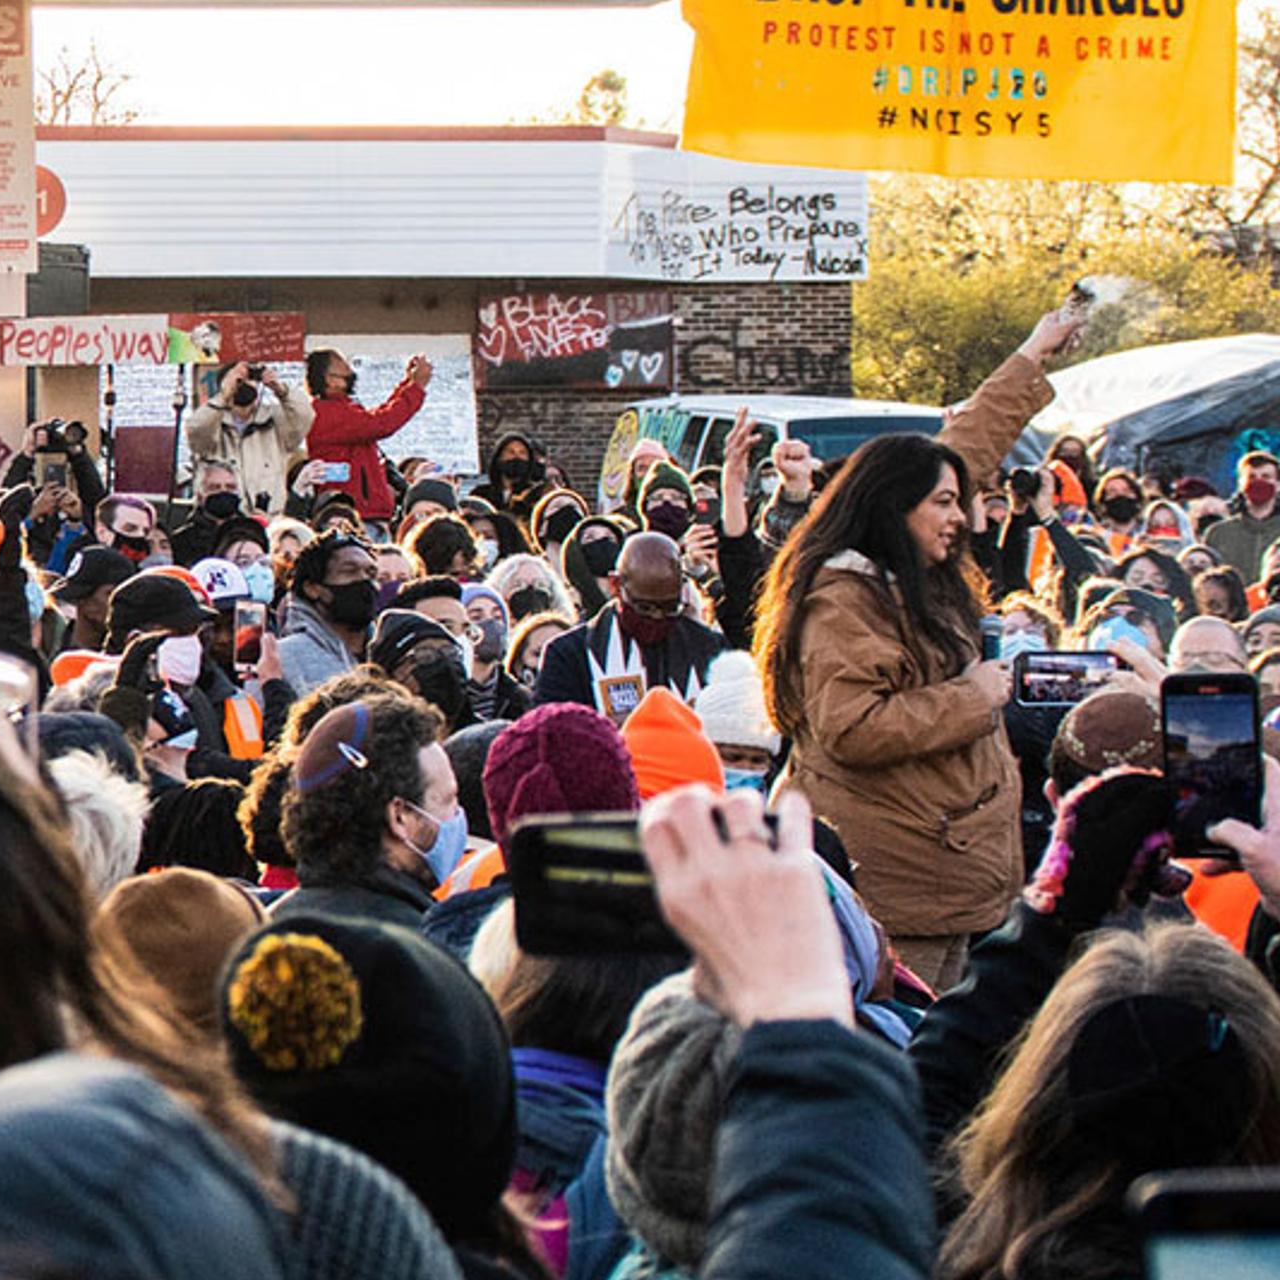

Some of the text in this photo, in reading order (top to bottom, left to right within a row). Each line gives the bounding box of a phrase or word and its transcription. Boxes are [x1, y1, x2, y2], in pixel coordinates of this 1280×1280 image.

[763, 21, 1172, 61] PROTEST IS NOT A CRIME
[37, 190, 48, 215] 1
[729, 185, 837, 220] Belongs
[699, 222, 759, 251] Who
[690, 252, 722, 279] It
[731, 246, 787, 280] Today
[502, 293, 606, 327] BLACK
